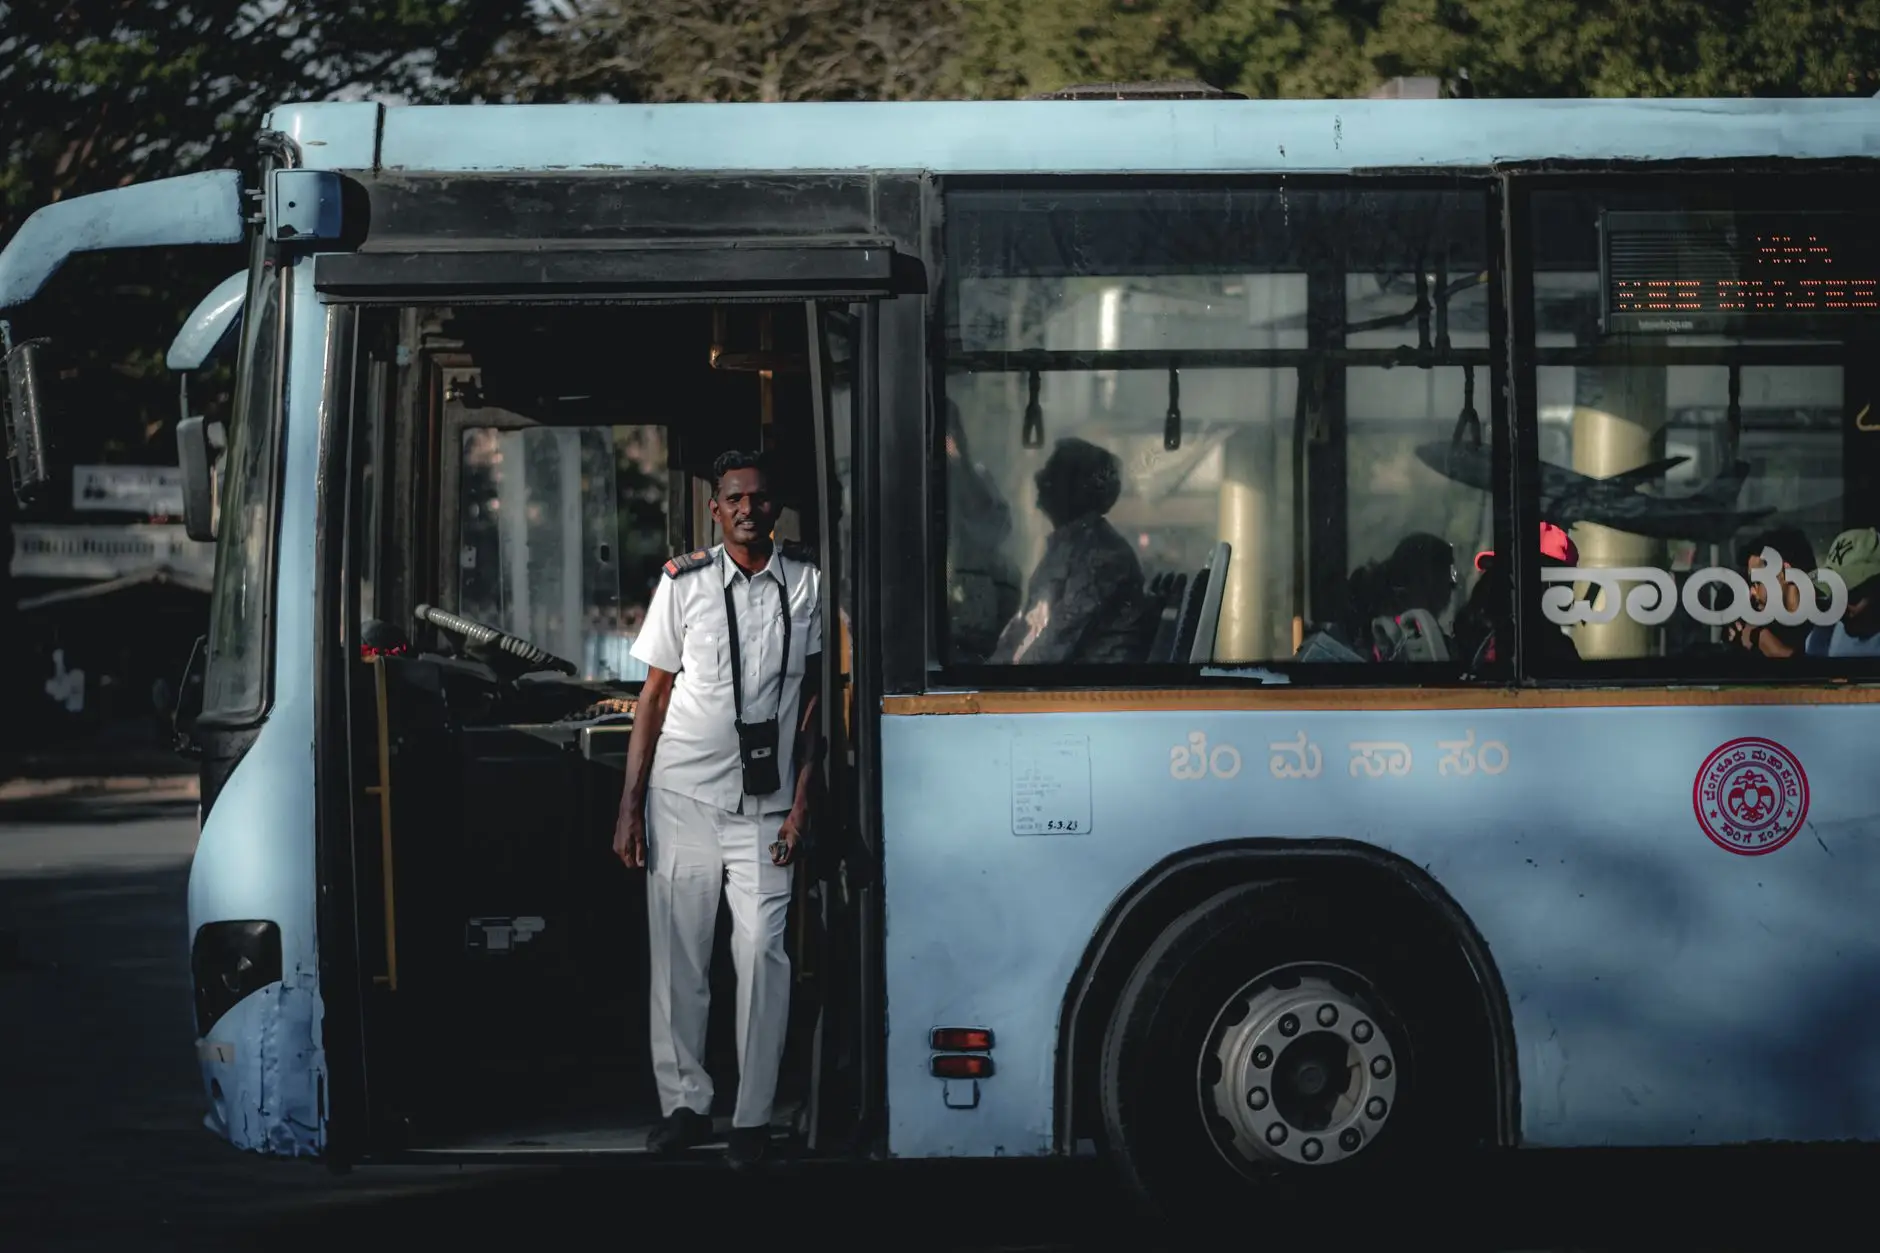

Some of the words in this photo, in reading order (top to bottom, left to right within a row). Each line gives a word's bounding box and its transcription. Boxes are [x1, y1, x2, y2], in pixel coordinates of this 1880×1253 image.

[1541, 546, 1848, 626] ವಾಯು
[1169, 730, 1242, 779] ಬೆಂ
[1269, 730, 1323, 779] ಮ
[1349, 740, 1412, 777] ಸಾ
[1437, 729, 1509, 776] ಸಂ
